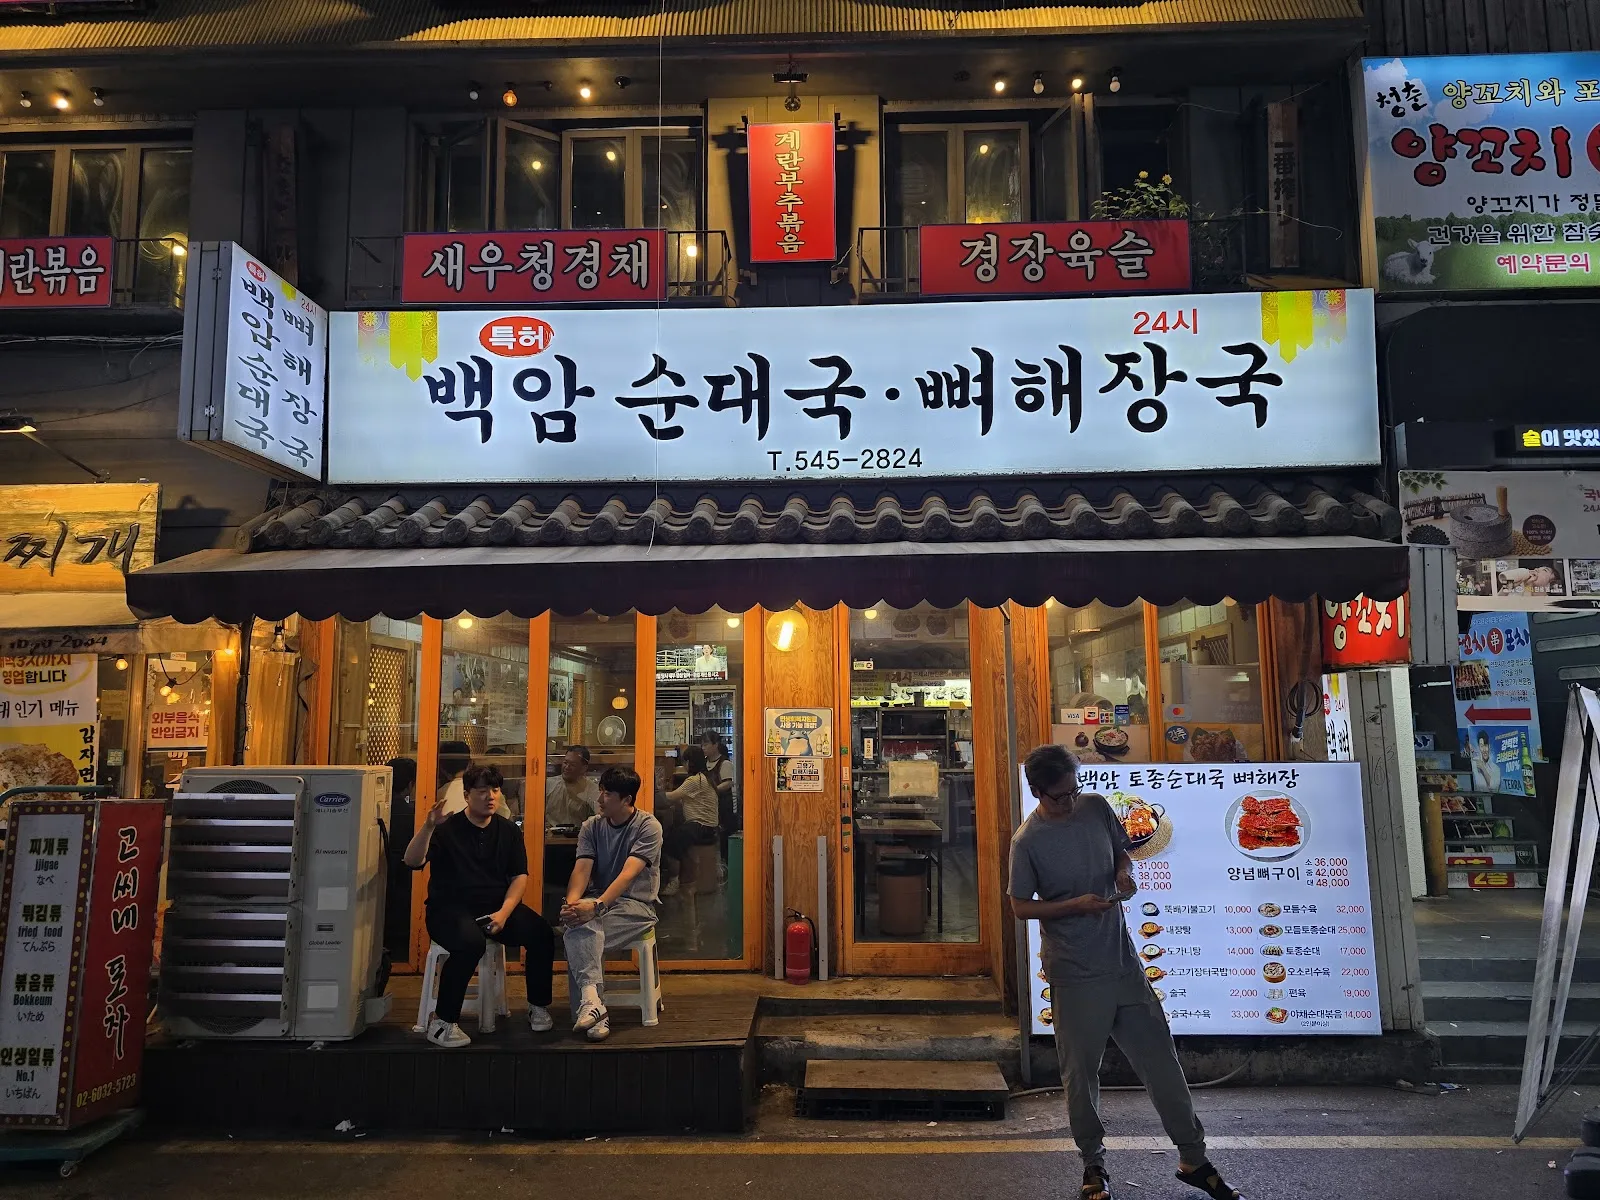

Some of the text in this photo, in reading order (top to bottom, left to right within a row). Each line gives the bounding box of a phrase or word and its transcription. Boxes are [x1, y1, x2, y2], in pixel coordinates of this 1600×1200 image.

[1443, 78, 1566, 109] 양꼬치와
[1391, 123, 1573, 187] 양꼬치
[775, 129, 804, 254] 계란부추볶음
[1467, 194, 1560, 214] 양꼬치가
[1428, 225, 1500, 245] 건강을
[1508, 224, 1555, 244] 위한
[961, 230, 1155, 282] 경장육슬
[423, 240, 649, 292] 새우청경채
[1496, 253, 1590, 274] 예약문의
[0, 246, 105, 295] 란볶음
[1133, 308, 1199, 335] 24시
[488, 324, 546, 351] 특허
[1522, 429, 1560, 447] 술이
[767, 448, 923, 471] T.545-2824
[3, 519, 140, 577] 찌개
[3, 670, 67, 685] 영업합니다
[15, 700, 43, 719] 인기
[50, 700, 80, 717] 메뉴
[151, 711, 200, 725] 외부음식
[151, 727, 199, 739] 반입금지
[1129, 768, 1225, 789] 토종순대국
[1234, 768, 1300, 788] 뼈해장
[1503, 779, 1523, 791] TERRA
[320, 795, 347, 803] Carrier
[29, 838, 69, 855] 찌개류
[35, 859, 58, 872] jjigae
[1137, 861, 1169, 872] 31,000
[1314, 858, 1348, 868] 36,000
[37, 874, 54, 885] なべ
[1138, 872, 1171, 882] 38,000
[1227, 867, 1300, 881] 양념뼈구이
[1315, 868, 1348, 878] 42,000
[1139, 881, 1172, 891] 45,000
[1316, 879, 1350, 888] 48,000
[22, 904, 62, 922] 튀김류
[1224, 906, 1252, 915] 10,000
[1336, 905, 1365, 914] 32,000
[18, 926, 62, 939] fried food
[1166, 926, 1253, 935] 내장탕 13,000
[1338, 926, 1366, 935] 25,000
[23, 941, 56, 953] てんぷら
[1167, 947, 1254, 956] 도가니탕 14,000
[1286, 947, 1366, 956] 토종순대 17,000
[1168, 968, 1256, 977] 소고기장터국밥 10,000
[1287, 968, 1370, 977] 오소리수육 22,000
[15, 973, 55, 992] 볶음류
[13, 994, 53, 1006] Bokkeum
[1229, 989, 1258, 998] 22,000
[1289, 989, 1371, 998] 편육 19,000
[18, 1012, 45, 1022] いため
[1231, 1010, 1260, 1019] 33,000
[1290, 1010, 1372, 1019] 야채순대볶음 14,000
[1, 1047, 55, 1067] 인생일류
[16, 1069, 35, 1082] No.1
[6, 1088, 41, 1099] いちばん
[76, 1073, 137, 1108] 02-6032-5723
